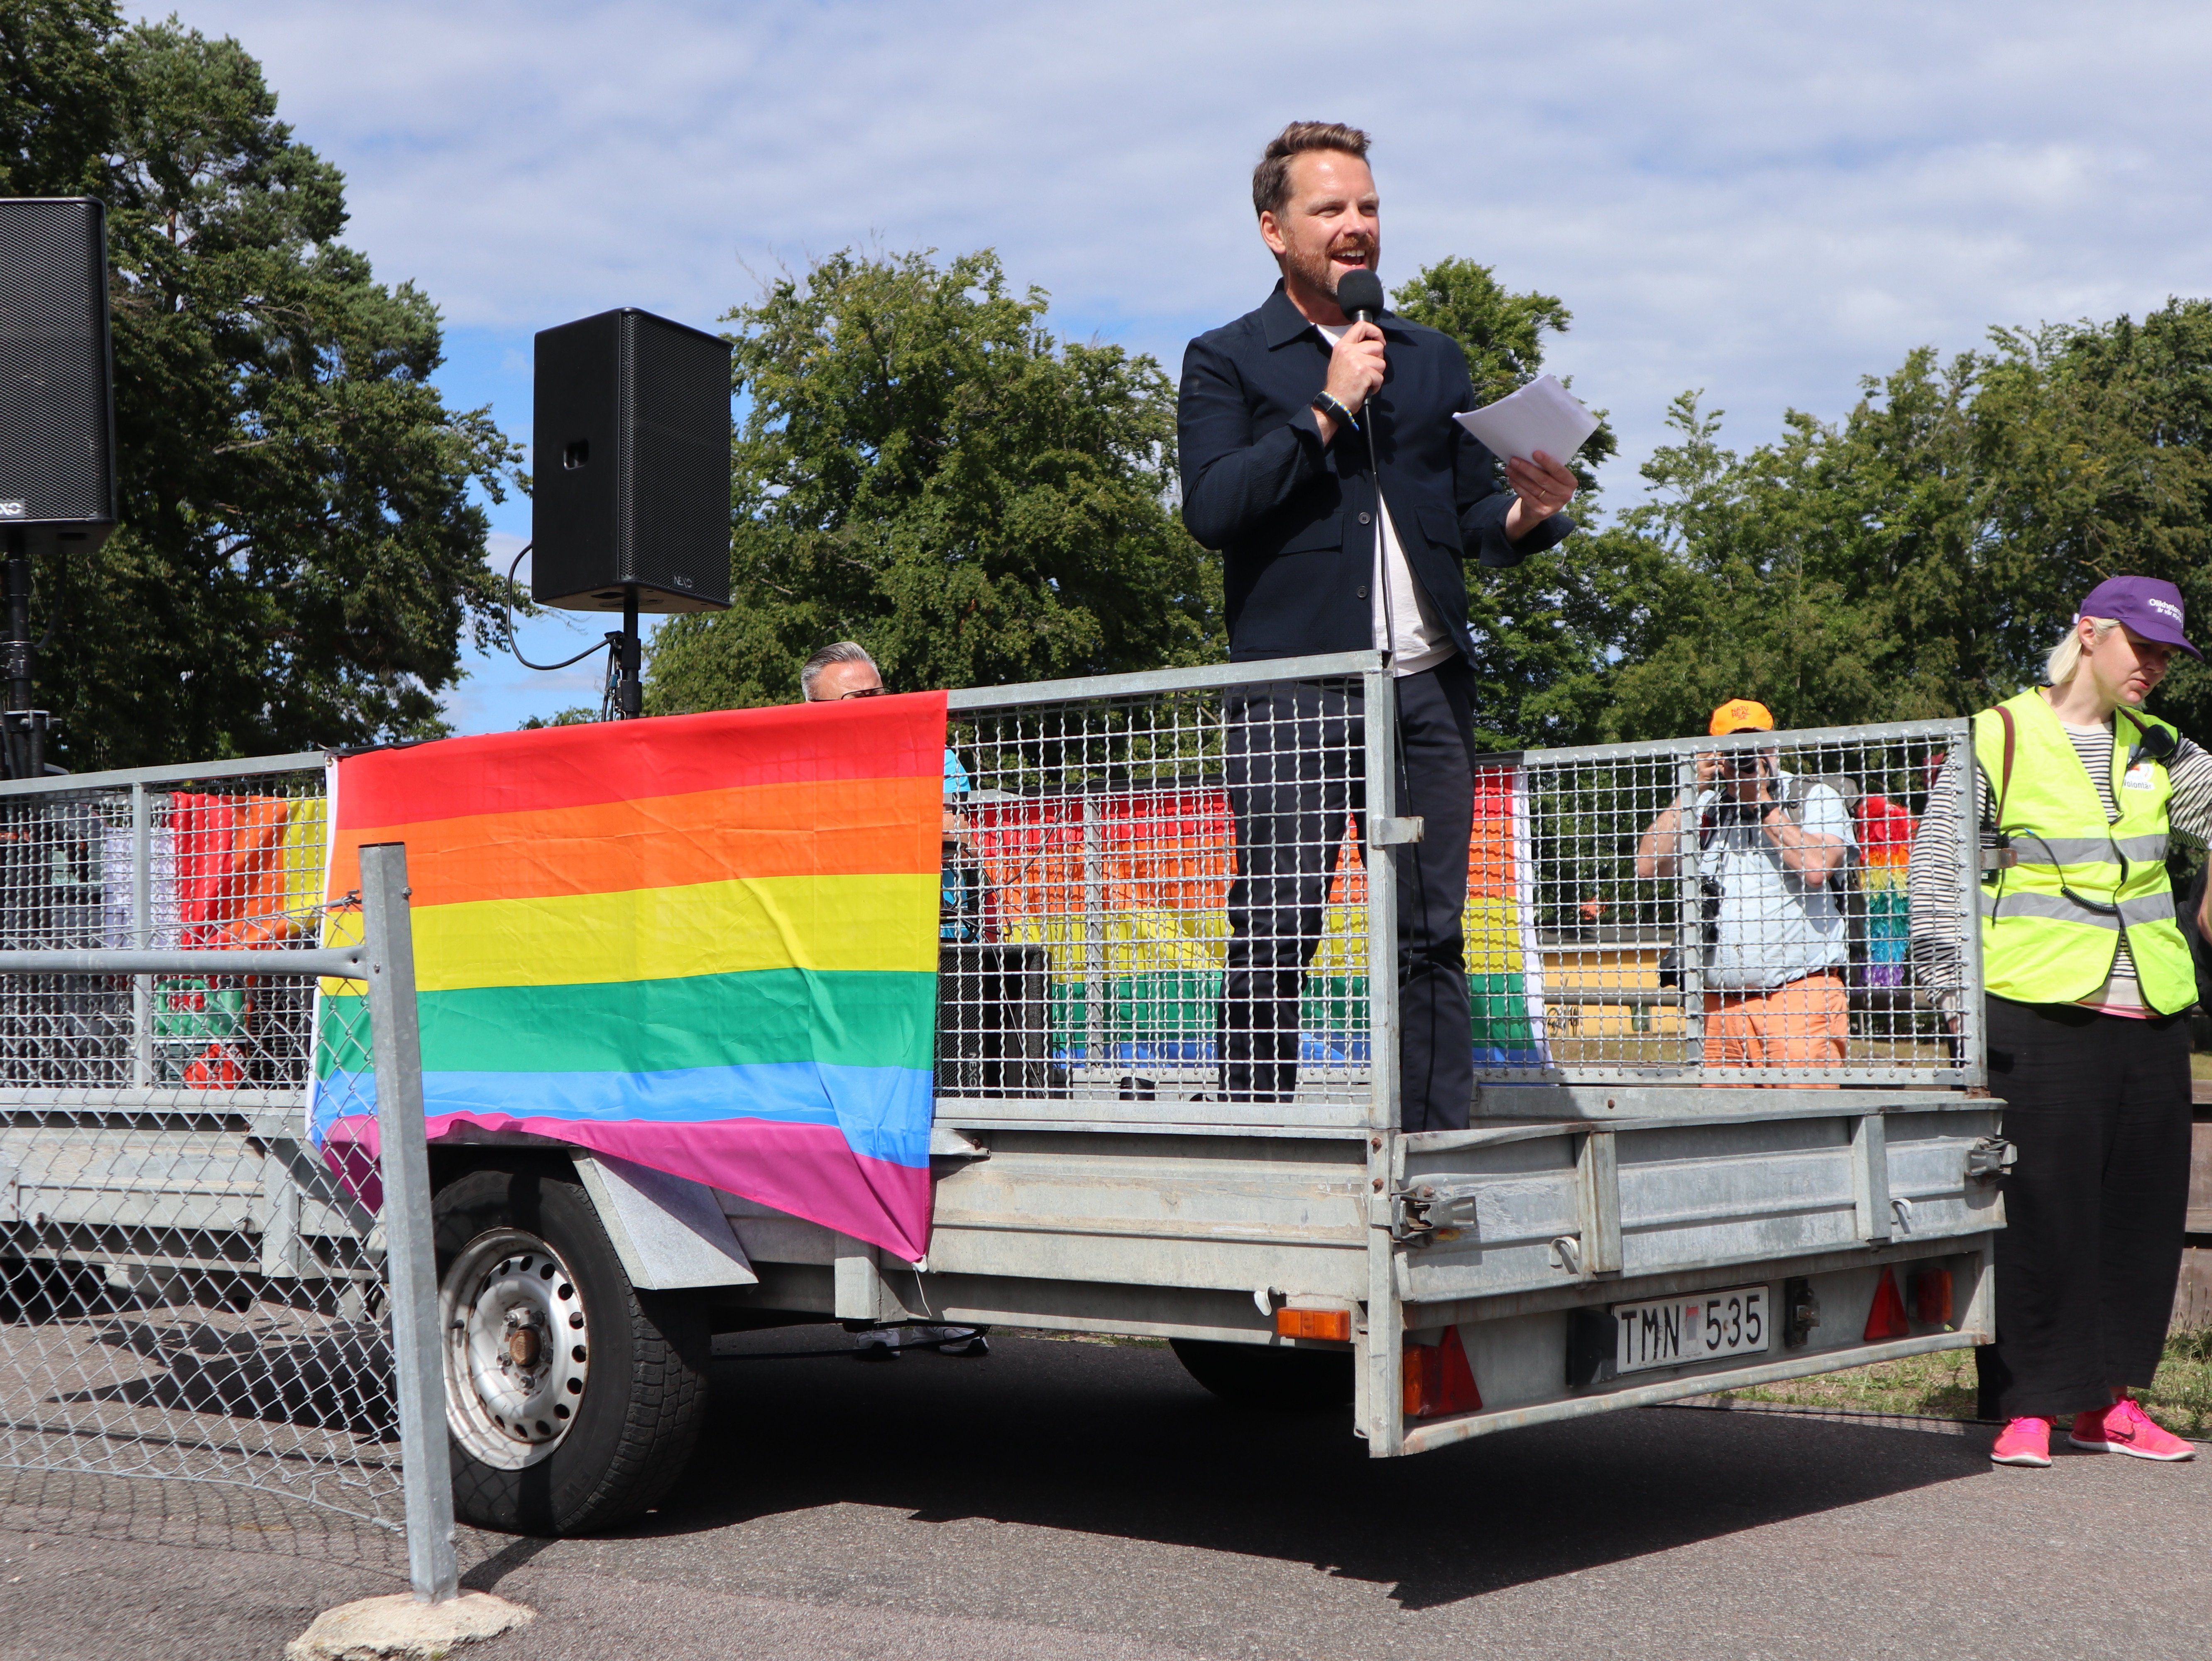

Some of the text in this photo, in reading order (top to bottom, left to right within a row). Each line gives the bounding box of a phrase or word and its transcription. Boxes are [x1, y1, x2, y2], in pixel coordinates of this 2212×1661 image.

[0, 502, 21, 515] XO
[674, 575, 692, 588] NEXO
[1732, 710, 1751, 718] REAL
[968, 1052, 978, 1088] NEXO
[1621, 1294, 1762, 1364] TMN 535
